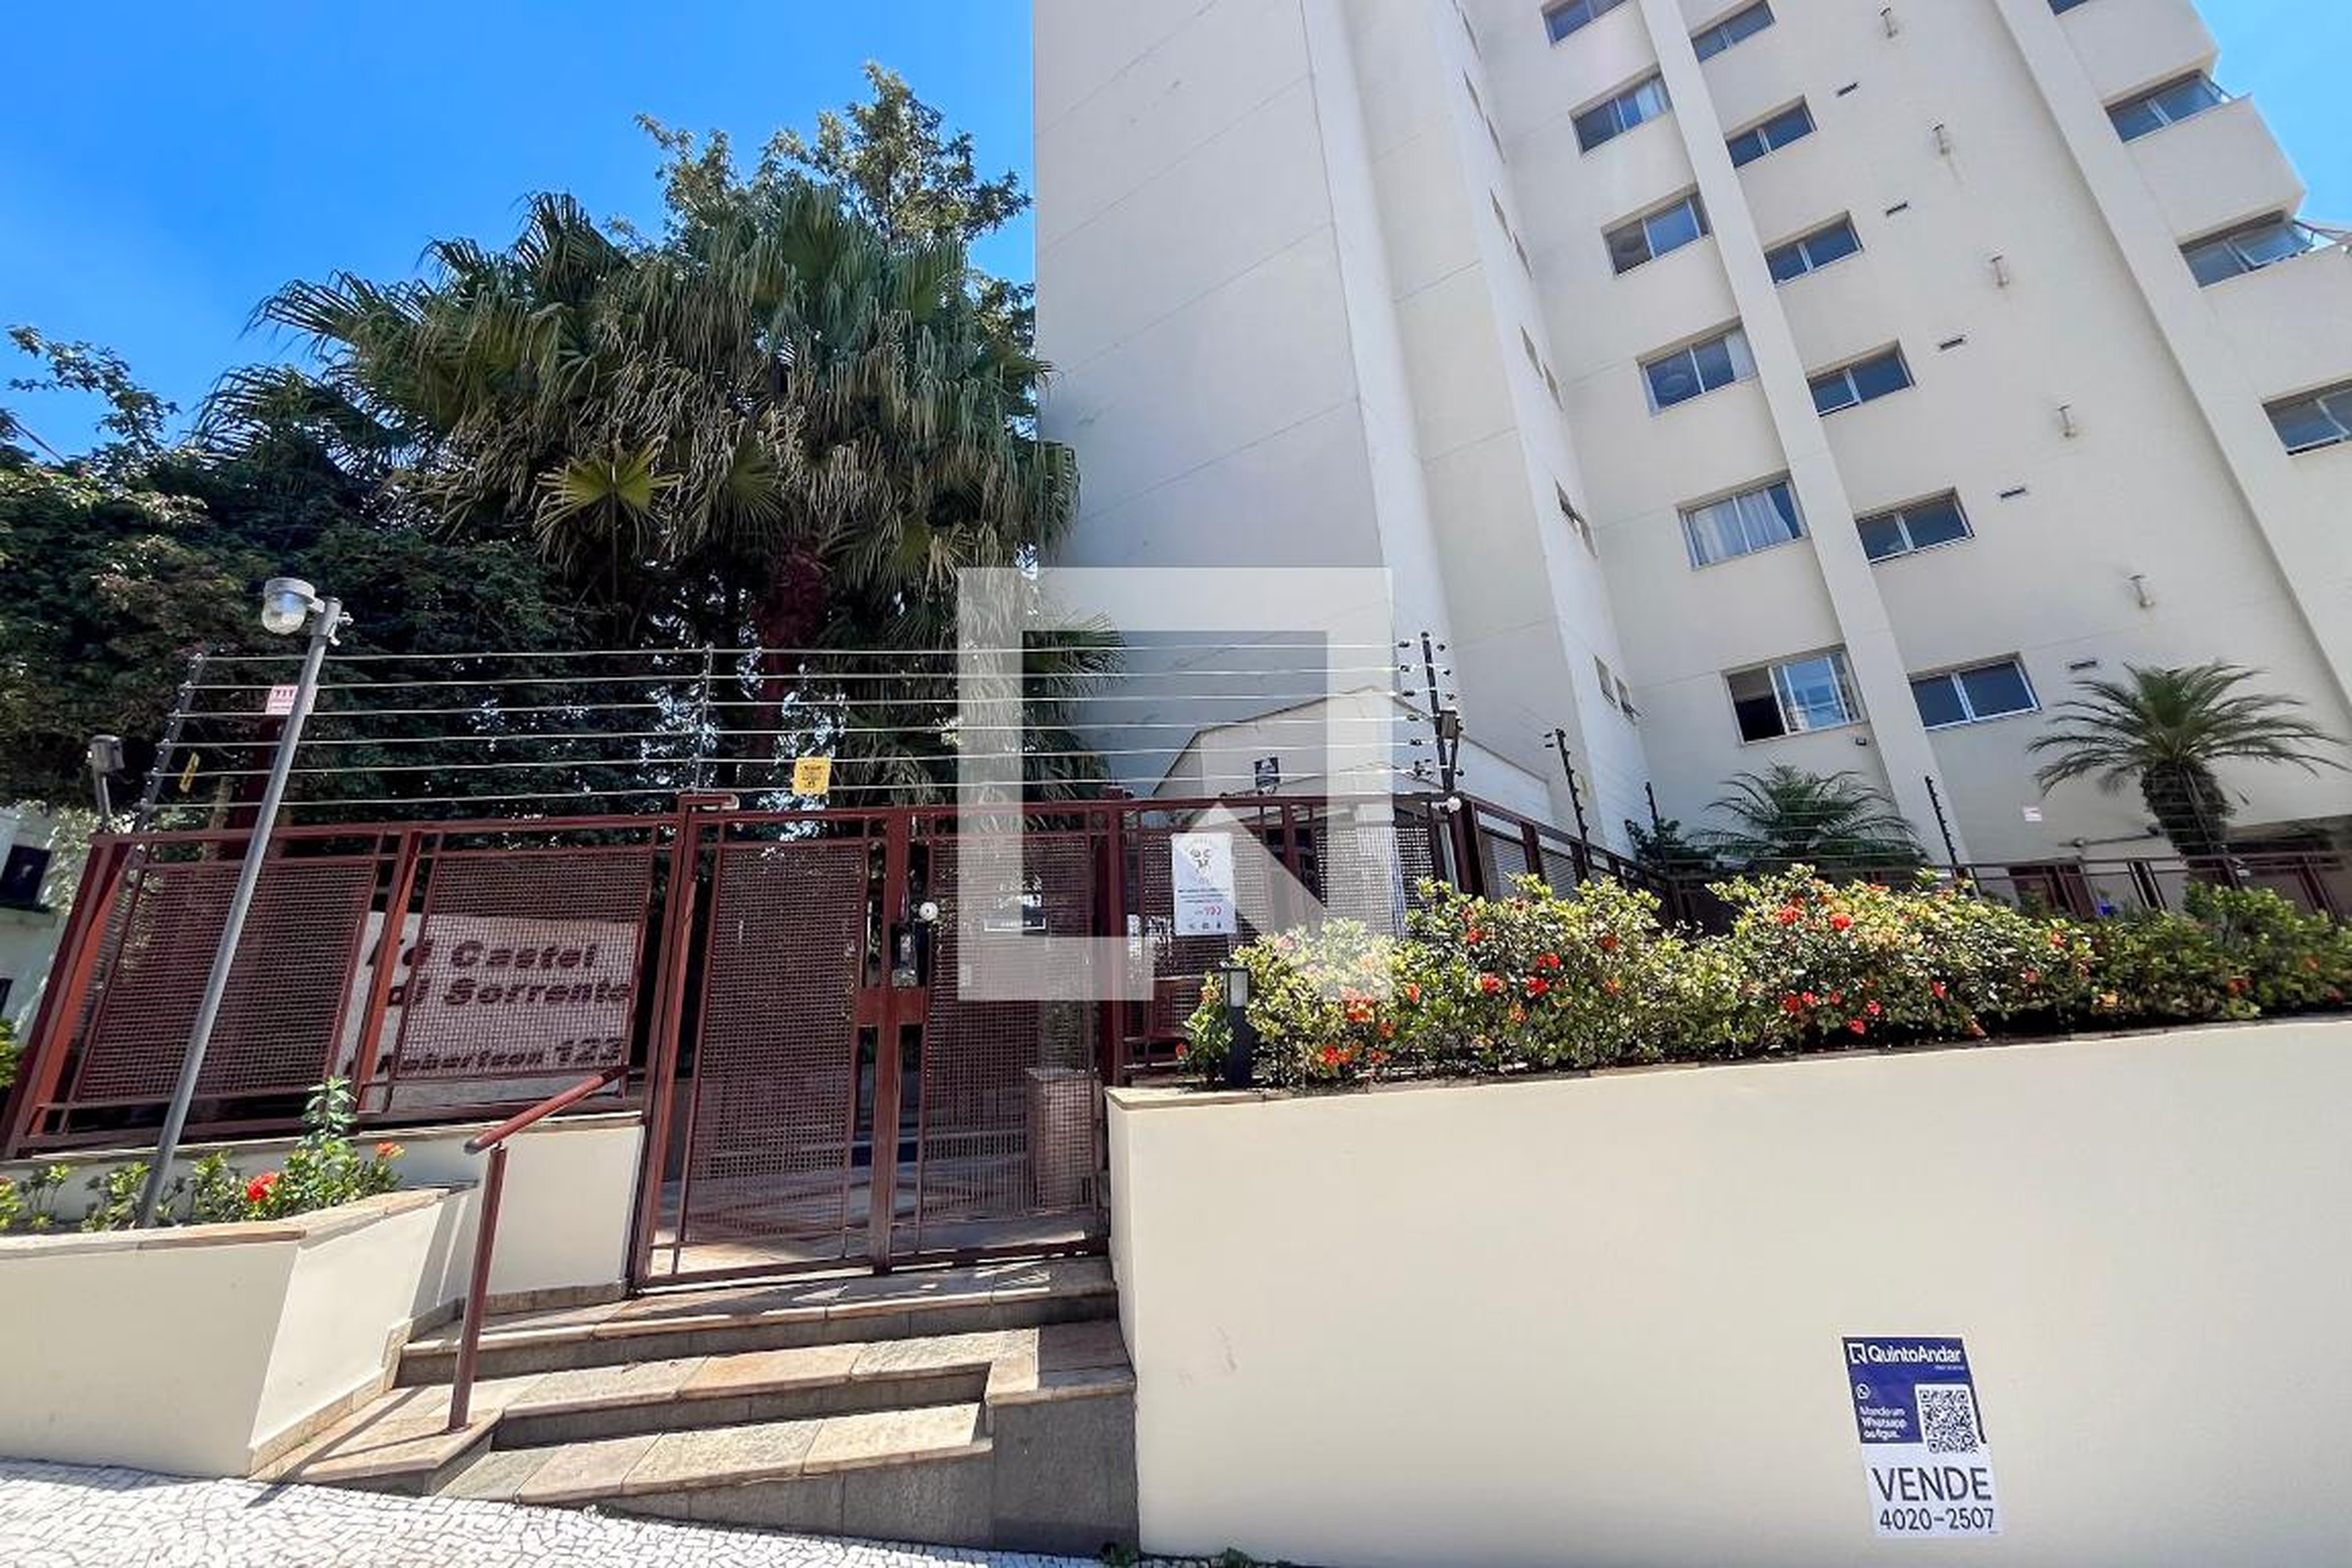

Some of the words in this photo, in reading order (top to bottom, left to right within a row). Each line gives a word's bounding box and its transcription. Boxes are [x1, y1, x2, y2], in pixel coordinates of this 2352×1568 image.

[451, 940, 598, 968] Castel
[444, 978, 632, 1005] Sorrento
[1868, 1345, 1961, 1363] QuintoAndar
[1871, 1467, 1992, 1502] VENDE
[1879, 1507, 1994, 1531] 4020-2507
